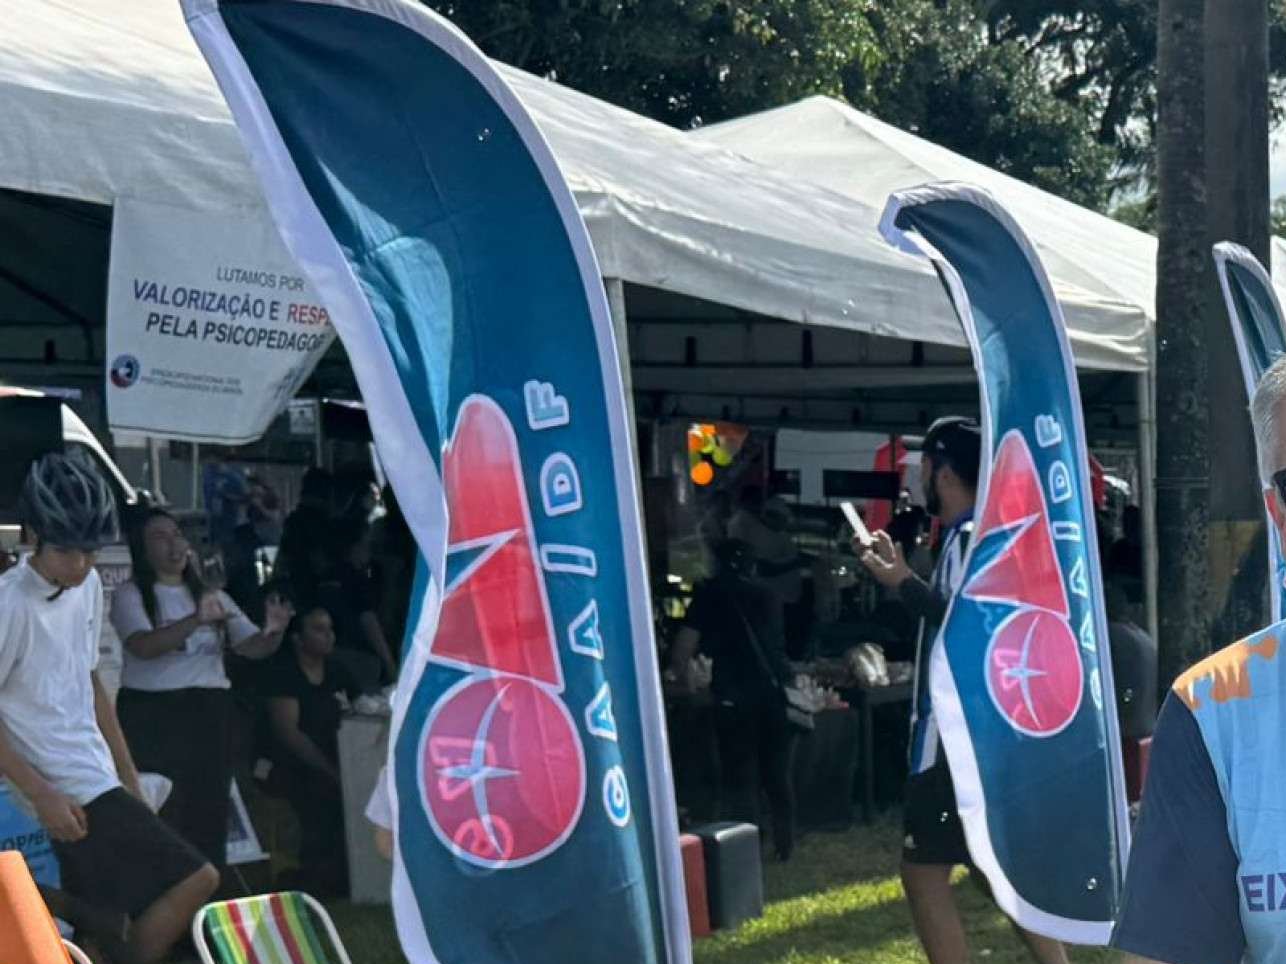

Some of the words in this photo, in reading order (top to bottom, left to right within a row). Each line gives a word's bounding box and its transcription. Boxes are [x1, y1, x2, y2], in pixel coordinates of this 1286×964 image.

[216, 266, 277, 289] LUTAMOS
[278, 275, 305, 292] POR
[133, 278, 266, 321] VALORIZAÇÃO
[269, 301, 281, 321] E
[286, 303, 330, 327] RESP
[145, 312, 198, 339] PELA
